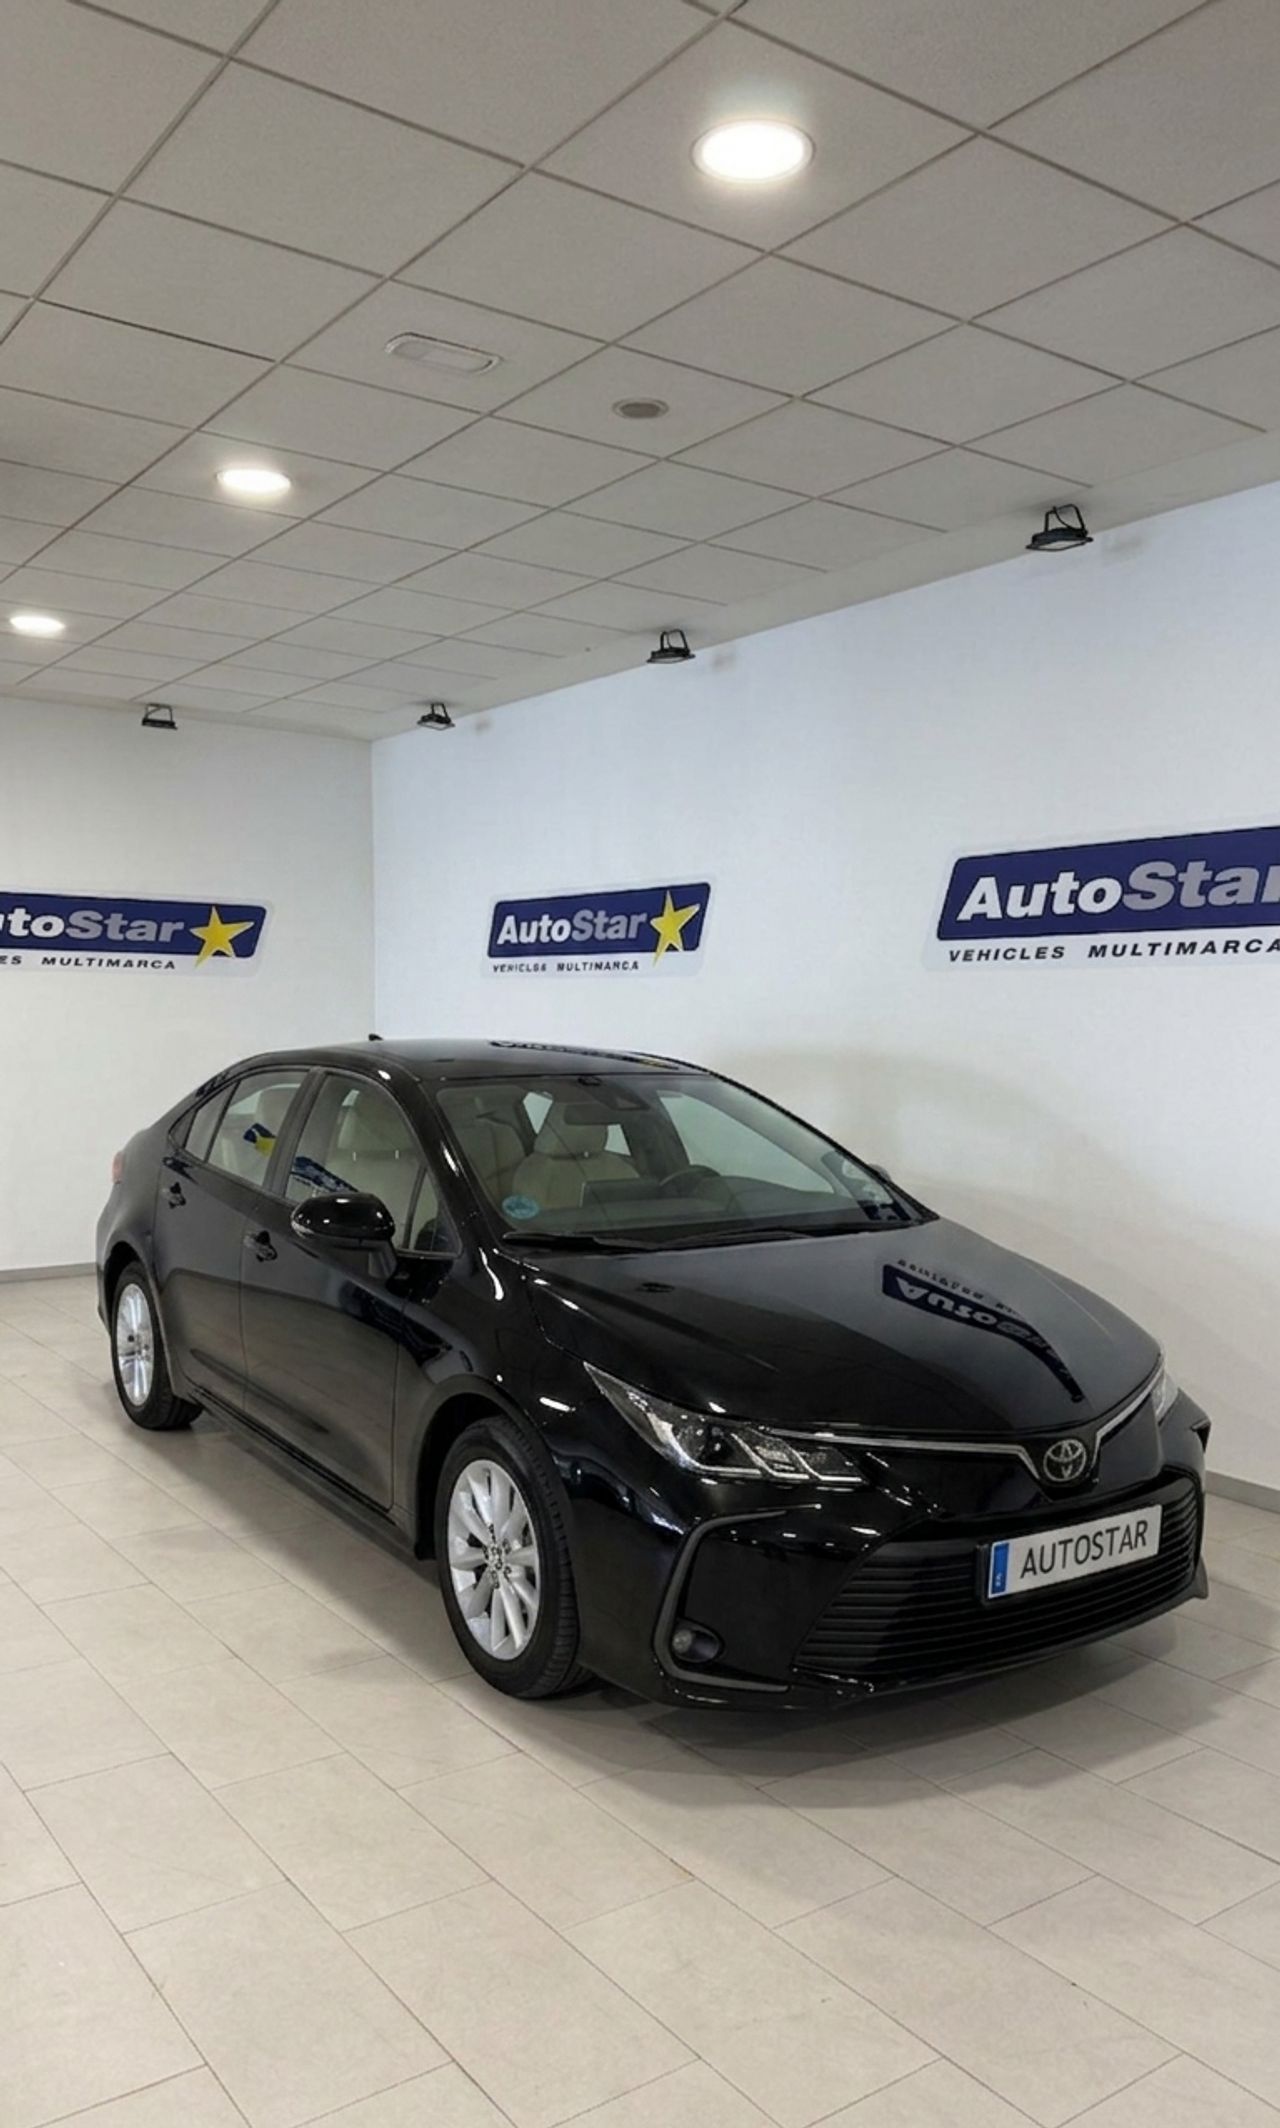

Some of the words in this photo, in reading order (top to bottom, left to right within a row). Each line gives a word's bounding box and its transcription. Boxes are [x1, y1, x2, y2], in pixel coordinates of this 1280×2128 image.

[0, 907, 184, 943] toStar
[497, 909, 648, 945] AutoStar
[41, 956, 176, 970] MULTIMARCA
[949, 946, 1065, 962] VEHICLES
[1088, 938, 1280, 958] MULTIMARCA
[1020, 1519, 1149, 1579] AUTOSTAR
